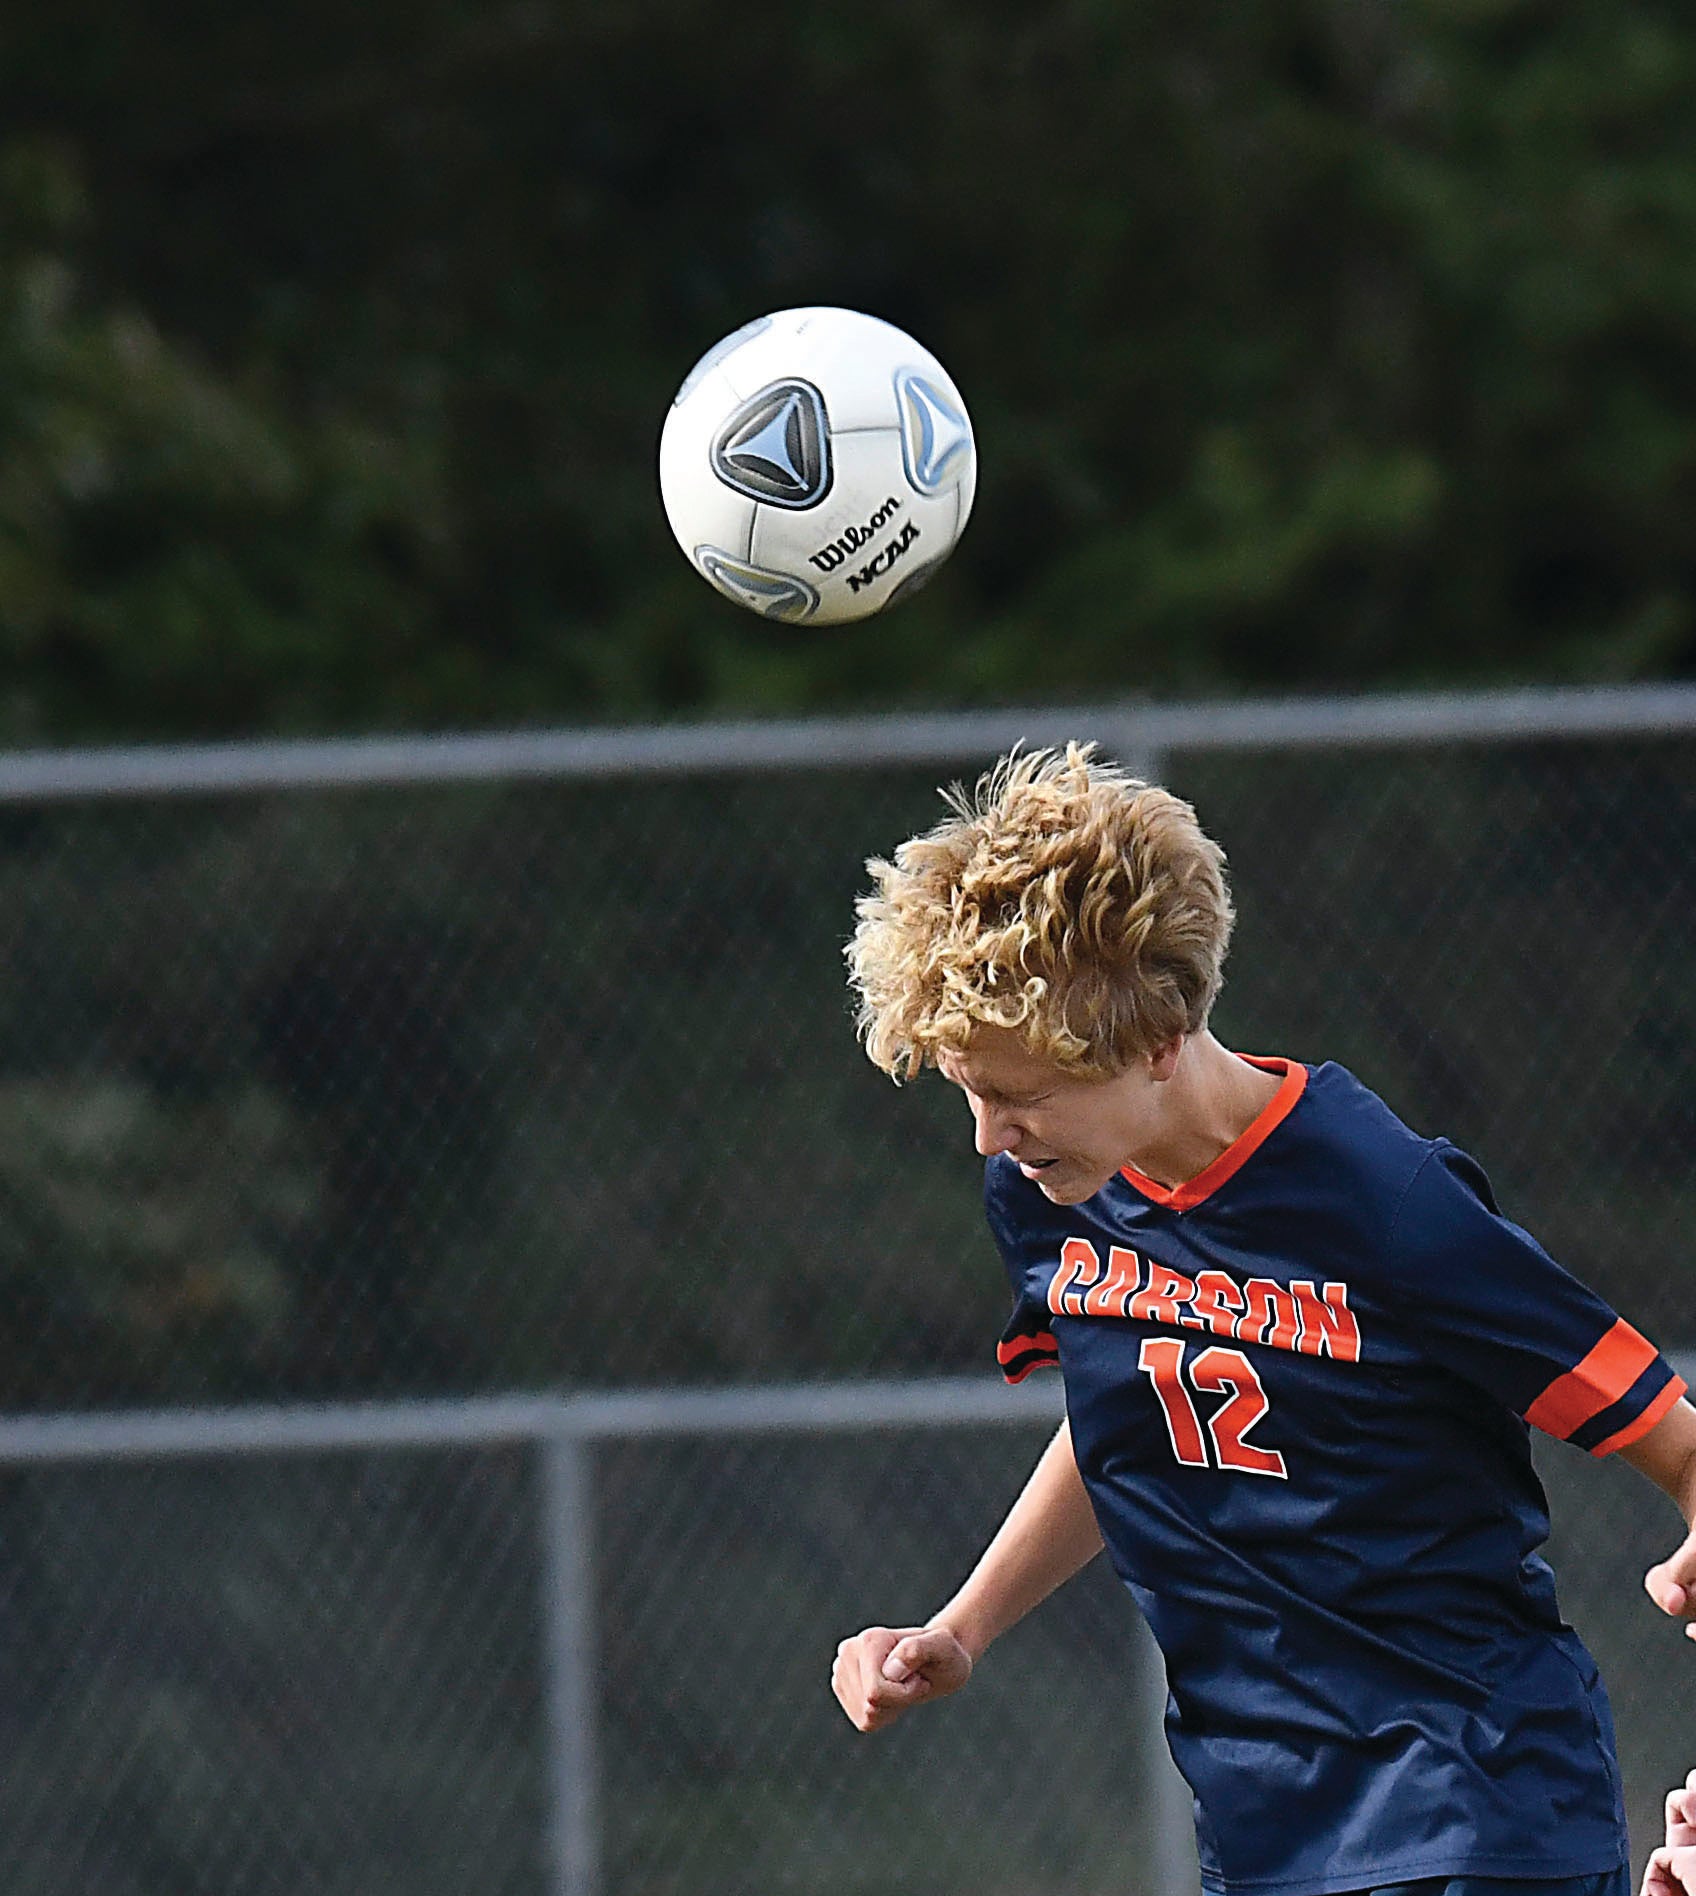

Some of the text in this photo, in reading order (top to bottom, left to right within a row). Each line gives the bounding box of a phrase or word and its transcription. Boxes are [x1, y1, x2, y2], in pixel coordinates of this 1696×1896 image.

[808, 497, 900, 572] Wilson
[845, 517, 921, 595] NCAA
[1048, 1236, 1361, 1363] CARSON
[1137, 1336, 1288, 1480] 12
